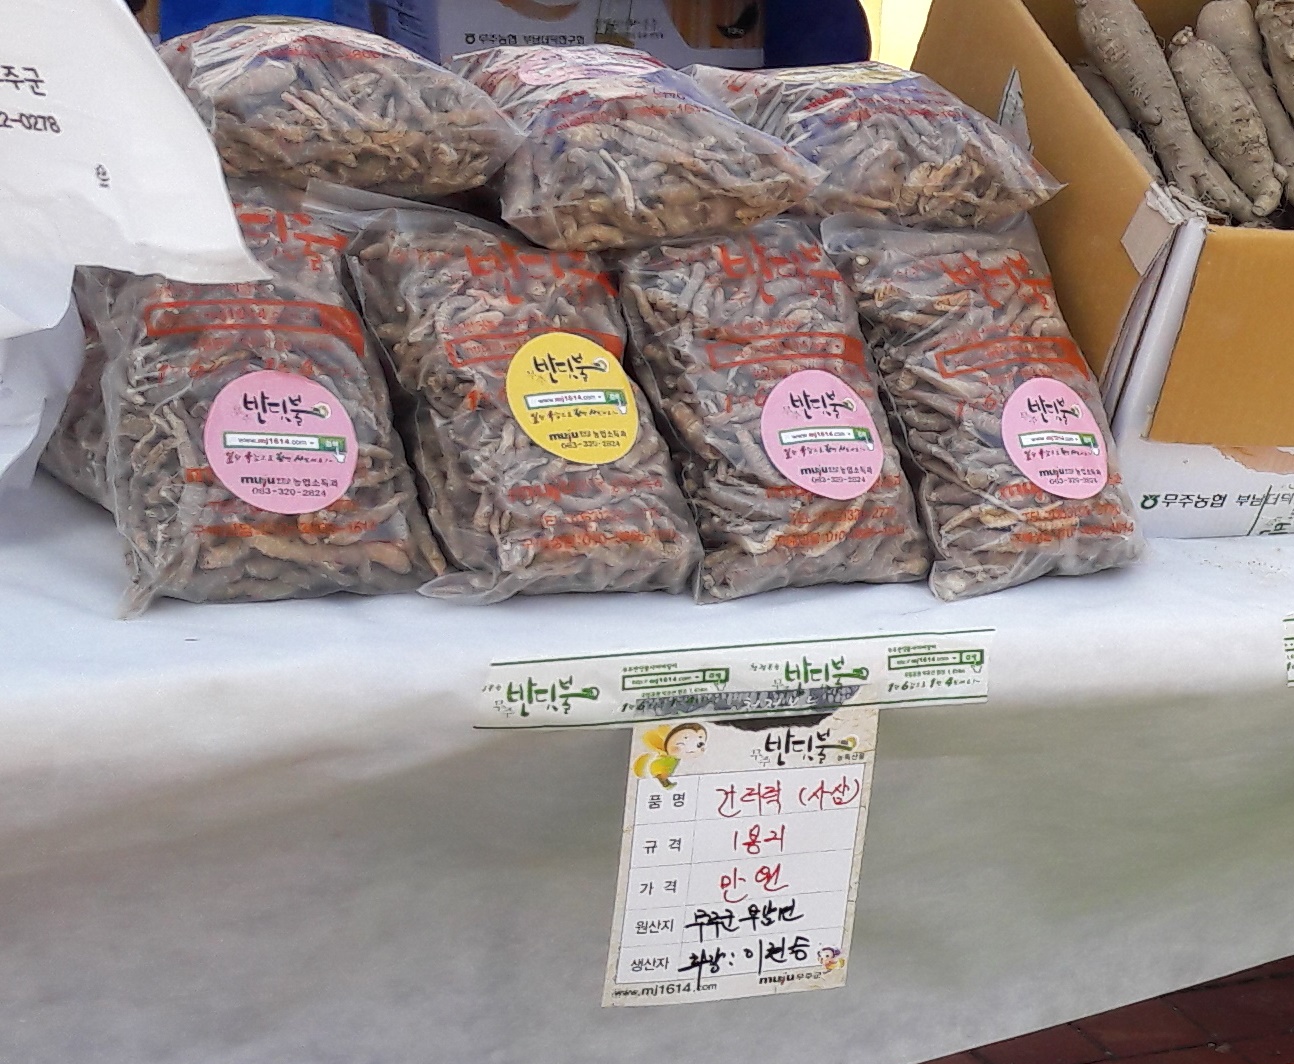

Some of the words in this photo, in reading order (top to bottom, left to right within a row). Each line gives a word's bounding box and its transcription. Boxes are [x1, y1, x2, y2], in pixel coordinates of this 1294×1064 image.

[0, 65, 46, 97] 주군
[1161, 493, 1227, 508] 무주농협
[507, 676, 600, 717] 반딧불
[765, 728, 858, 766] 반딧불
[634, 918, 674, 935] 원산지
[630, 957, 670, 972] 생산자
[611, 983, 717, 998] www.mj1614.com
